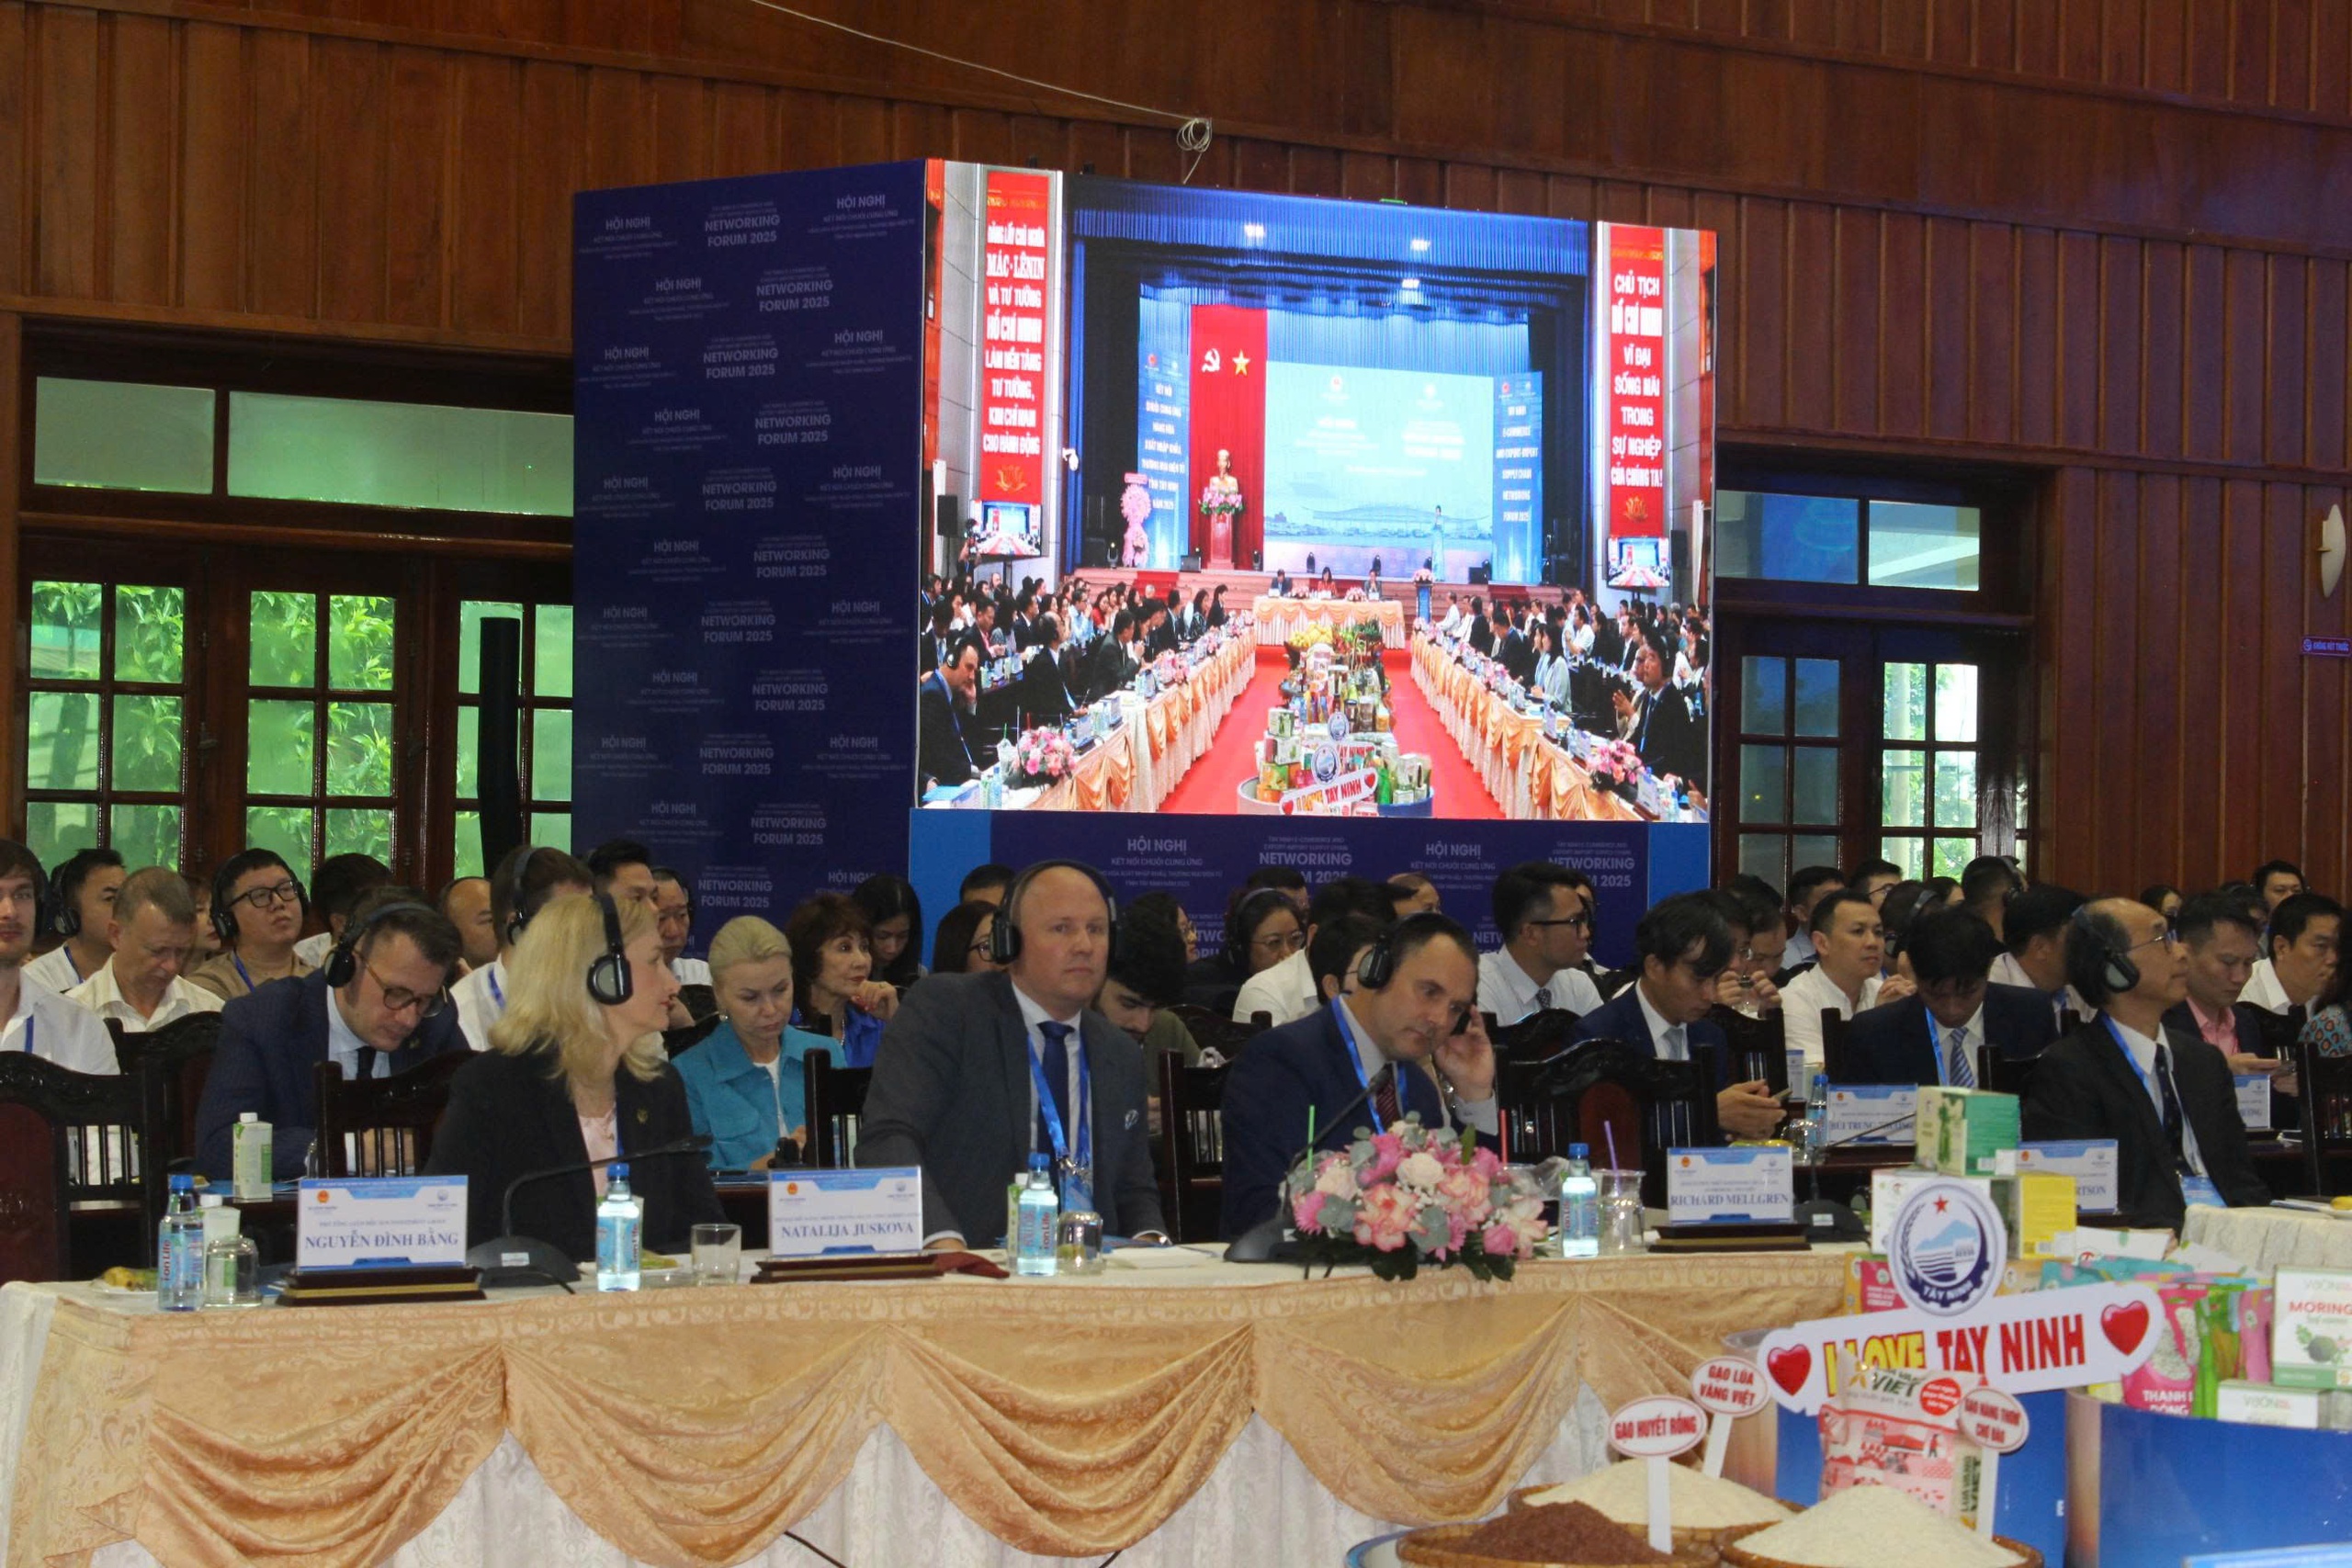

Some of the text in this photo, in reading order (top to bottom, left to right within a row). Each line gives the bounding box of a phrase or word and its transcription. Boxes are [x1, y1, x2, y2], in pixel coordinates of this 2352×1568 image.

[837, 194, 886, 209] HỘI NGHỊ
[706, 215, 780, 231] NETWORKING
[708, 231, 776, 246] FORUM 2025
[757, 280, 832, 295] NETWORKING
[1614, 270, 1660, 299] CHỦ TỊCH
[760, 297, 830, 311] FORUM 2025
[834, 329, 883, 344] HỘI NGHỊ
[704, 348, 778, 362] NETWORKING
[707, 366, 775, 378] FORUM 2025
[1614, 371, 1641, 396] SỐNG
[755, 415, 831, 428] NETWORKING
[1621, 406, 1654, 426] TRONG
[758, 431, 828, 445] FORUM 2025
[1612, 434, 1662, 460] SỰ NGHIỆP
[833, 465, 881, 479] HỘI NGHỊ
[703, 481, 776, 494] NETWORKING
[706, 498, 774, 510] FORUM 2025
[754, 549, 830, 561] NETWORKING
[757, 565, 827, 578] FORUM 2025
[832, 601, 879, 614] HỘI NGHỊ
[702, 615, 775, 626] NETWORKING
[705, 630, 772, 642] FORUM 2025
[752, 683, 828, 694] NETWORKING
[756, 700, 825, 710] FORUM 2025
[831, 737, 878, 750] HỘI NGHỊ
[700, 748, 774, 758] NETWORKING
[703, 764, 770, 773] FORUM 2025
[1326, 779, 1363, 804] TAY NINH
[752, 818, 826, 829] NETWORKING
[755, 834, 823, 844] FORUM 2025
[1127, 835, 1187, 855] HỘI NGHỊ
[1426, 840, 1481, 860] HỘI NGHỊ
[1259, 852, 1352, 865] NETWORKING
[698, 880, 772, 891] NETWORKING
[1600, 874, 1631, 887] 2025
[701, 896, 769, 908] FORUM 2025
[1671, 1193, 1789, 1206] RICHARD MELLGREN
[782, 1222, 914, 1238] NATALIJA JUSKOVA
[305, 1226, 458, 1248] NGUYỄN ĐÌNH BẰNG
[1937, 1325, 1991, 1385] TAY
[2000, 1314, 2085, 1373] NINH
[2142, 1390, 2187, 1403] THANH
